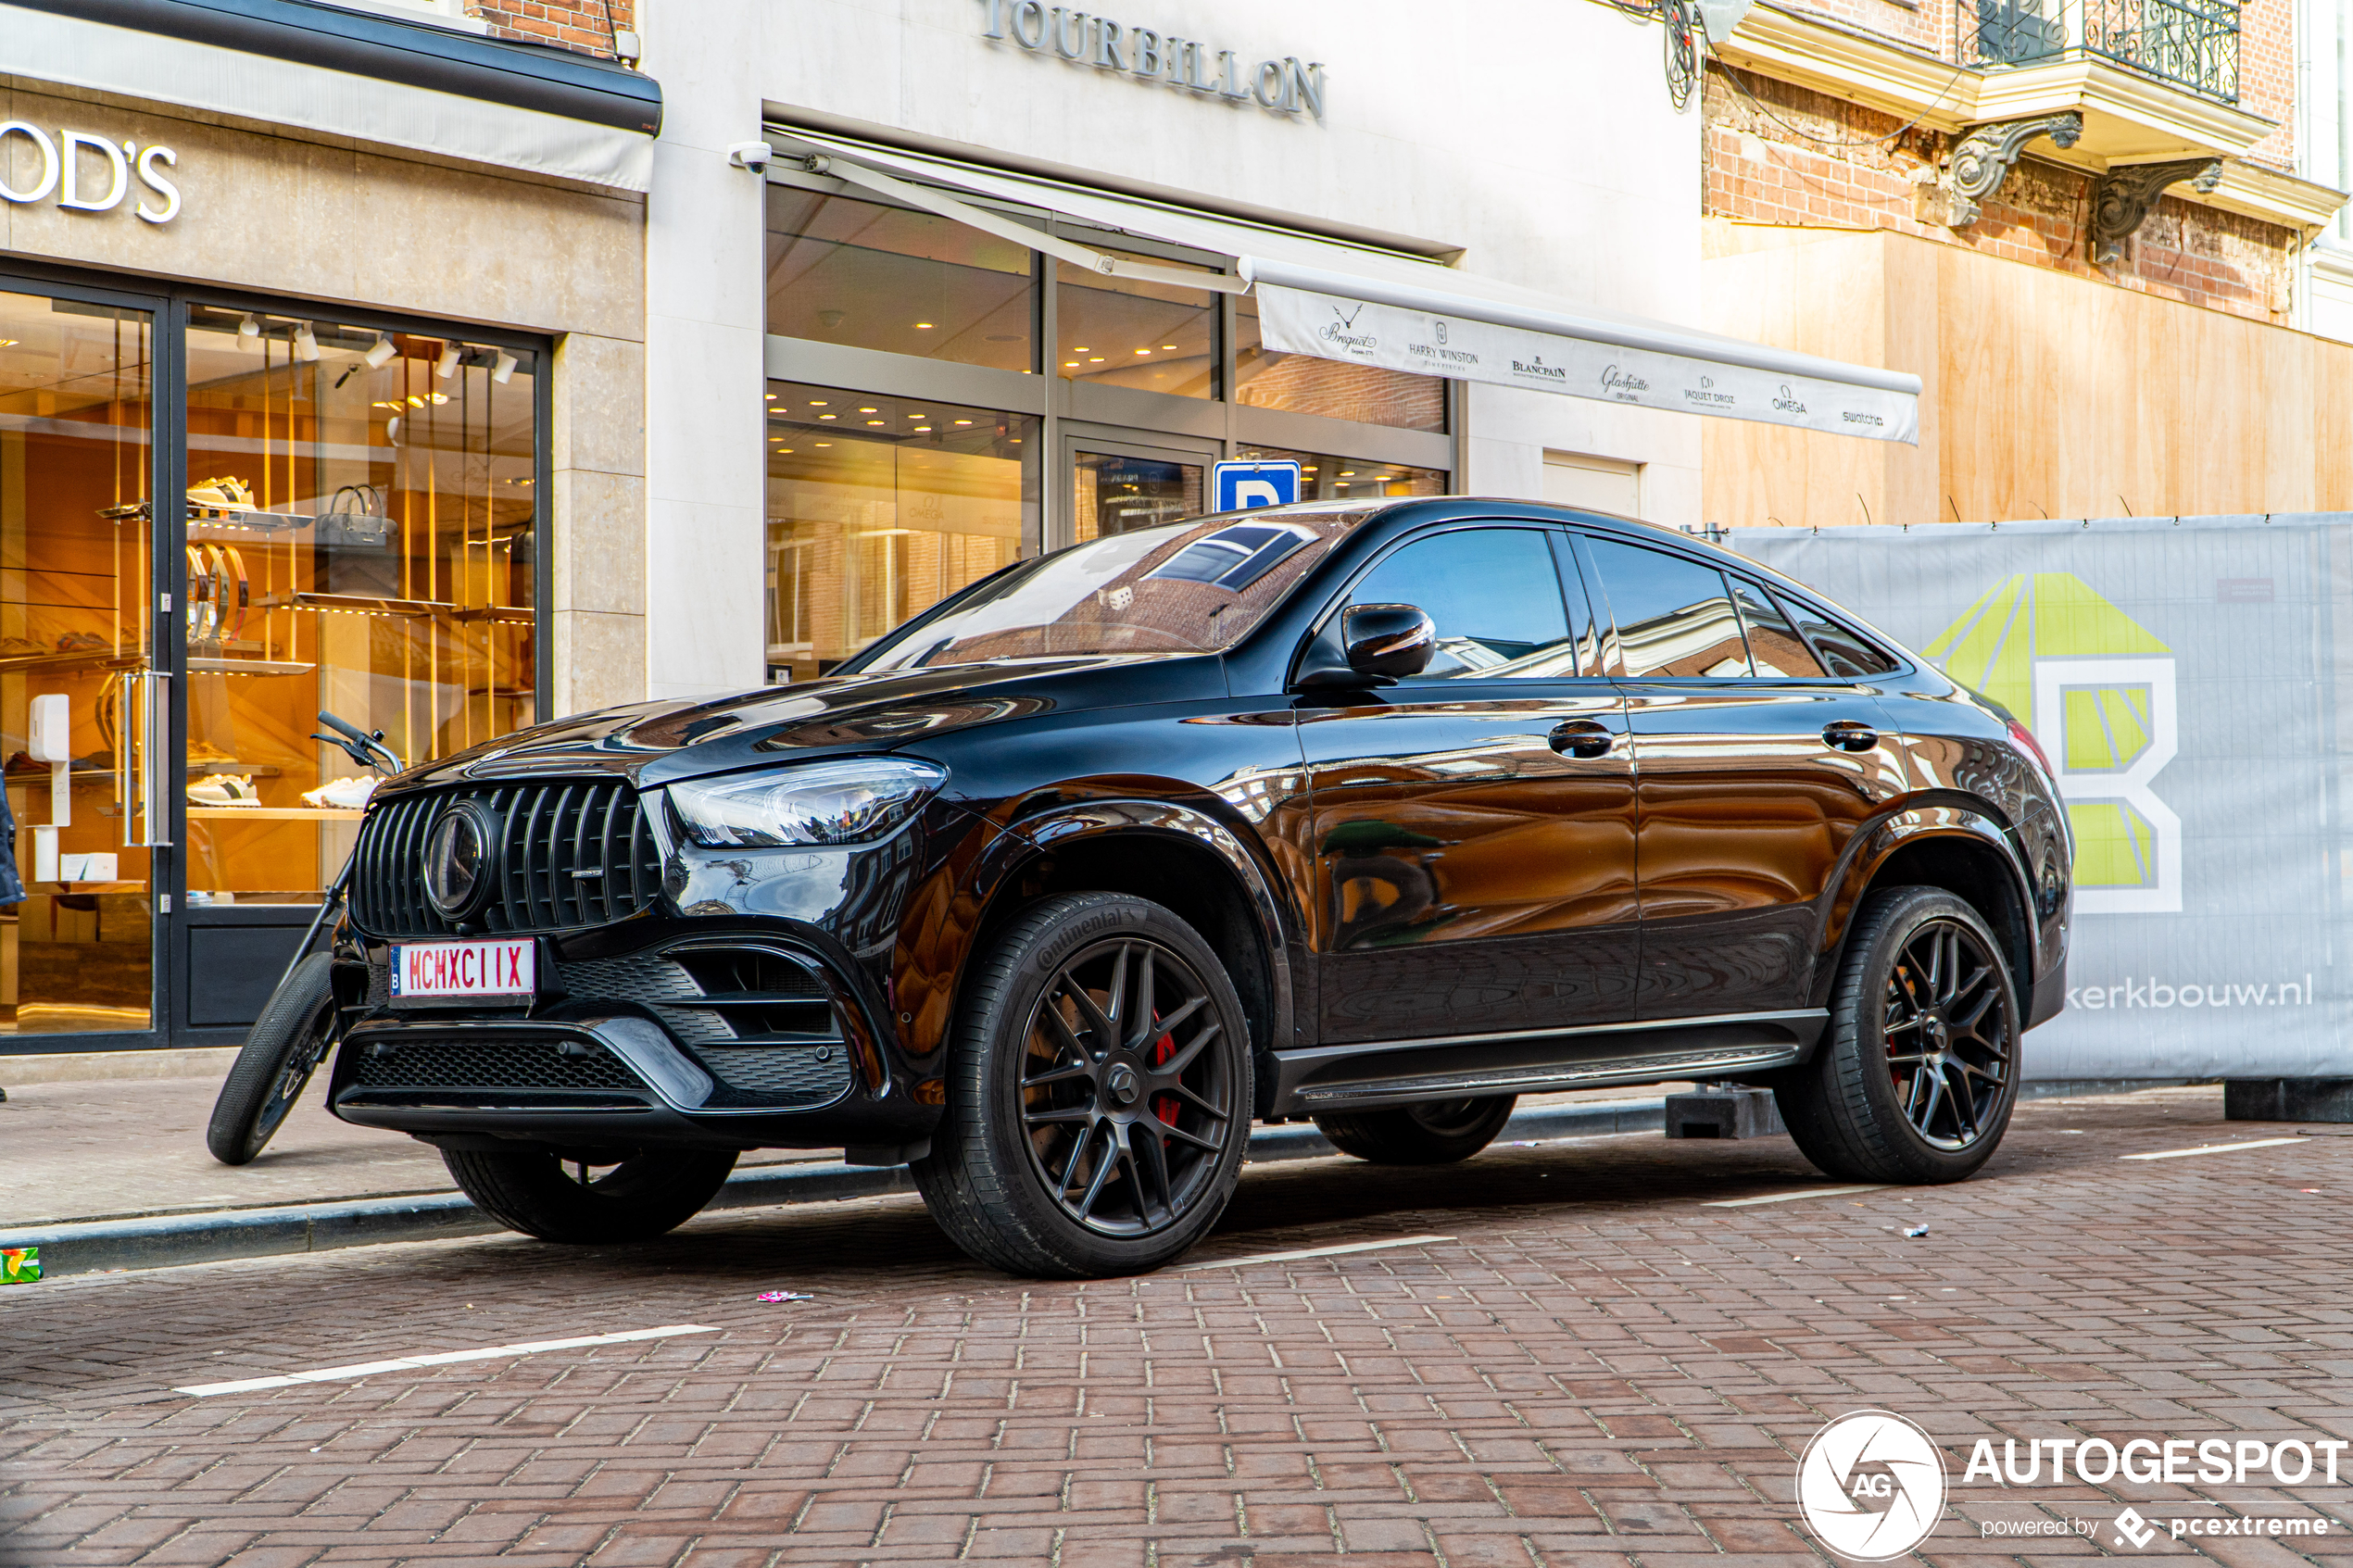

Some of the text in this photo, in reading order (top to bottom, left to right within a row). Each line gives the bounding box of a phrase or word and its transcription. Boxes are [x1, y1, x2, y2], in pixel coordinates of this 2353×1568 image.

[980, 0, 1326, 119] TOURBILLON
[1319, 322, 1377, 352] Breguet
[1409, 344, 1478, 365] HARRY WINSTON
[1512, 360, 1566, 378] BLANCPAIN
[1602, 365, 1651, 393] Glashütte
[1617, 393, 1640, 402] ORIGINAL
[1683, 389, 1736, 405] JAQUET DROZ
[1772, 398, 1807, 415] OMEGA
[1843, 411, 1877, 425] swatch
[1036, 908, 1122, 972] Continental
[409, 946, 522, 990] MCMXCIIX
[391, 973, 399, 988] B
